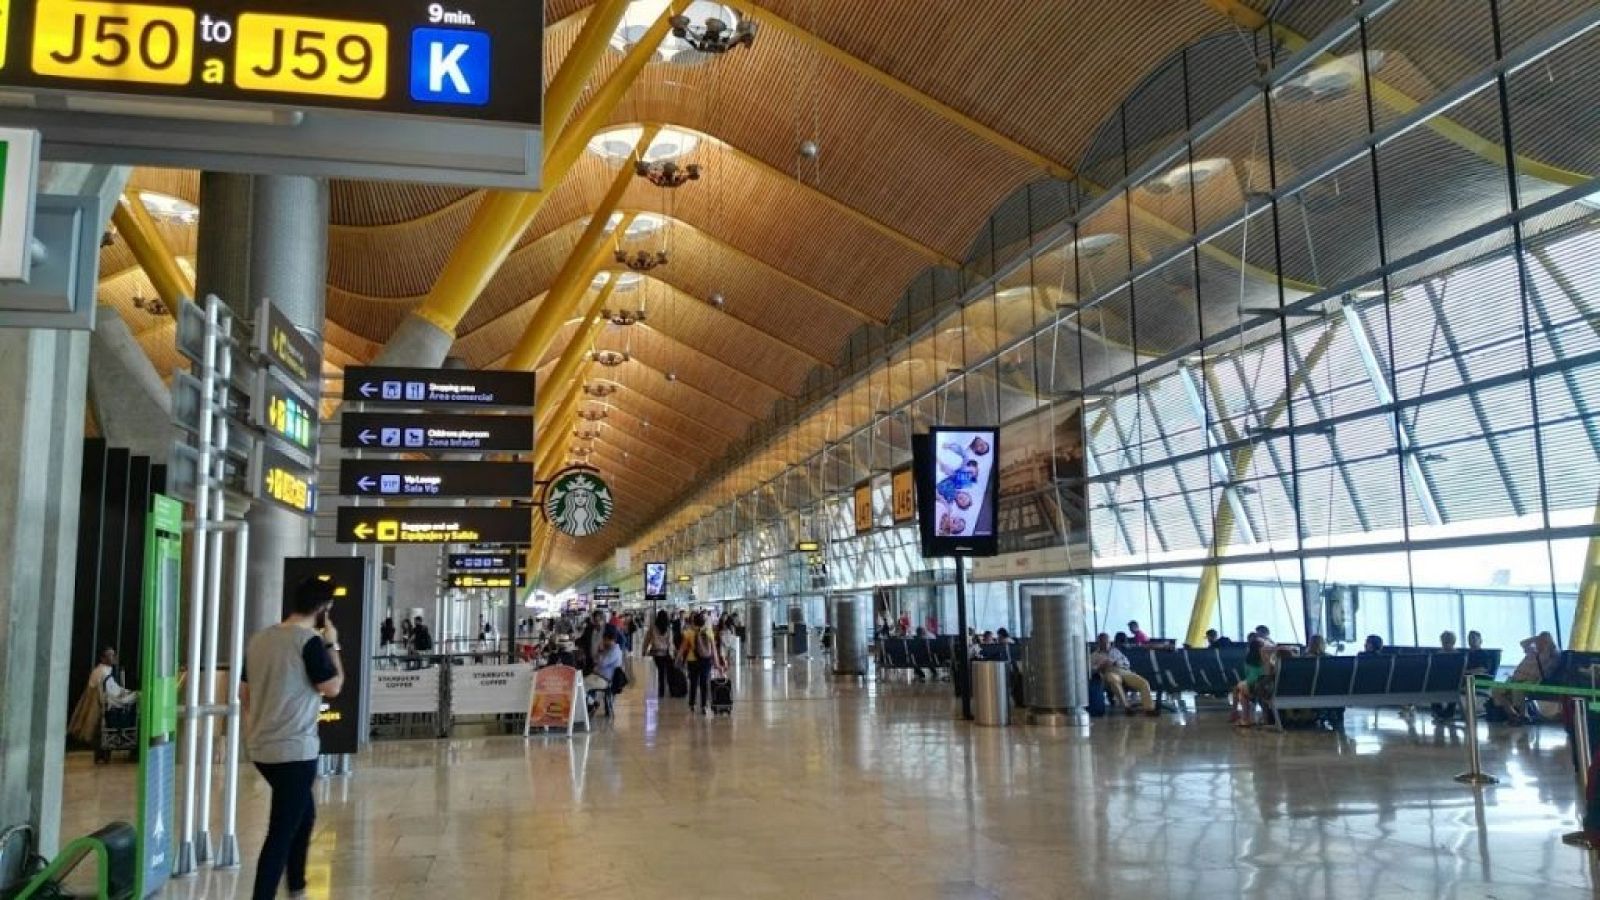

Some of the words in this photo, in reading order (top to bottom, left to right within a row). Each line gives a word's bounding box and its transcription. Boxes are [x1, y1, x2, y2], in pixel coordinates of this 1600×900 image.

[50, 13, 179, 71] J50
[200, 14, 231, 42] to
[252, 28, 373, 84] J59
[202, 58, 225, 84] a
[429, 41, 471, 94] K
[429, 383, 459, 393] Shopping
[460, 385, 476, 393] area
[451, 393, 493, 401] comercial
[428, 438, 449, 447] Zona
[383, 480, 398, 489] VIP
[404, 483, 423, 492] Sala
[425, 483, 439, 494] Vip
[896, 488, 911, 516] J46
[444, 532, 452, 542] y
[377, 674, 420, 682] STARBUCKS
[472, 671, 515, 679] STARBUCKS
[480, 679, 507, 687] COFFEE
